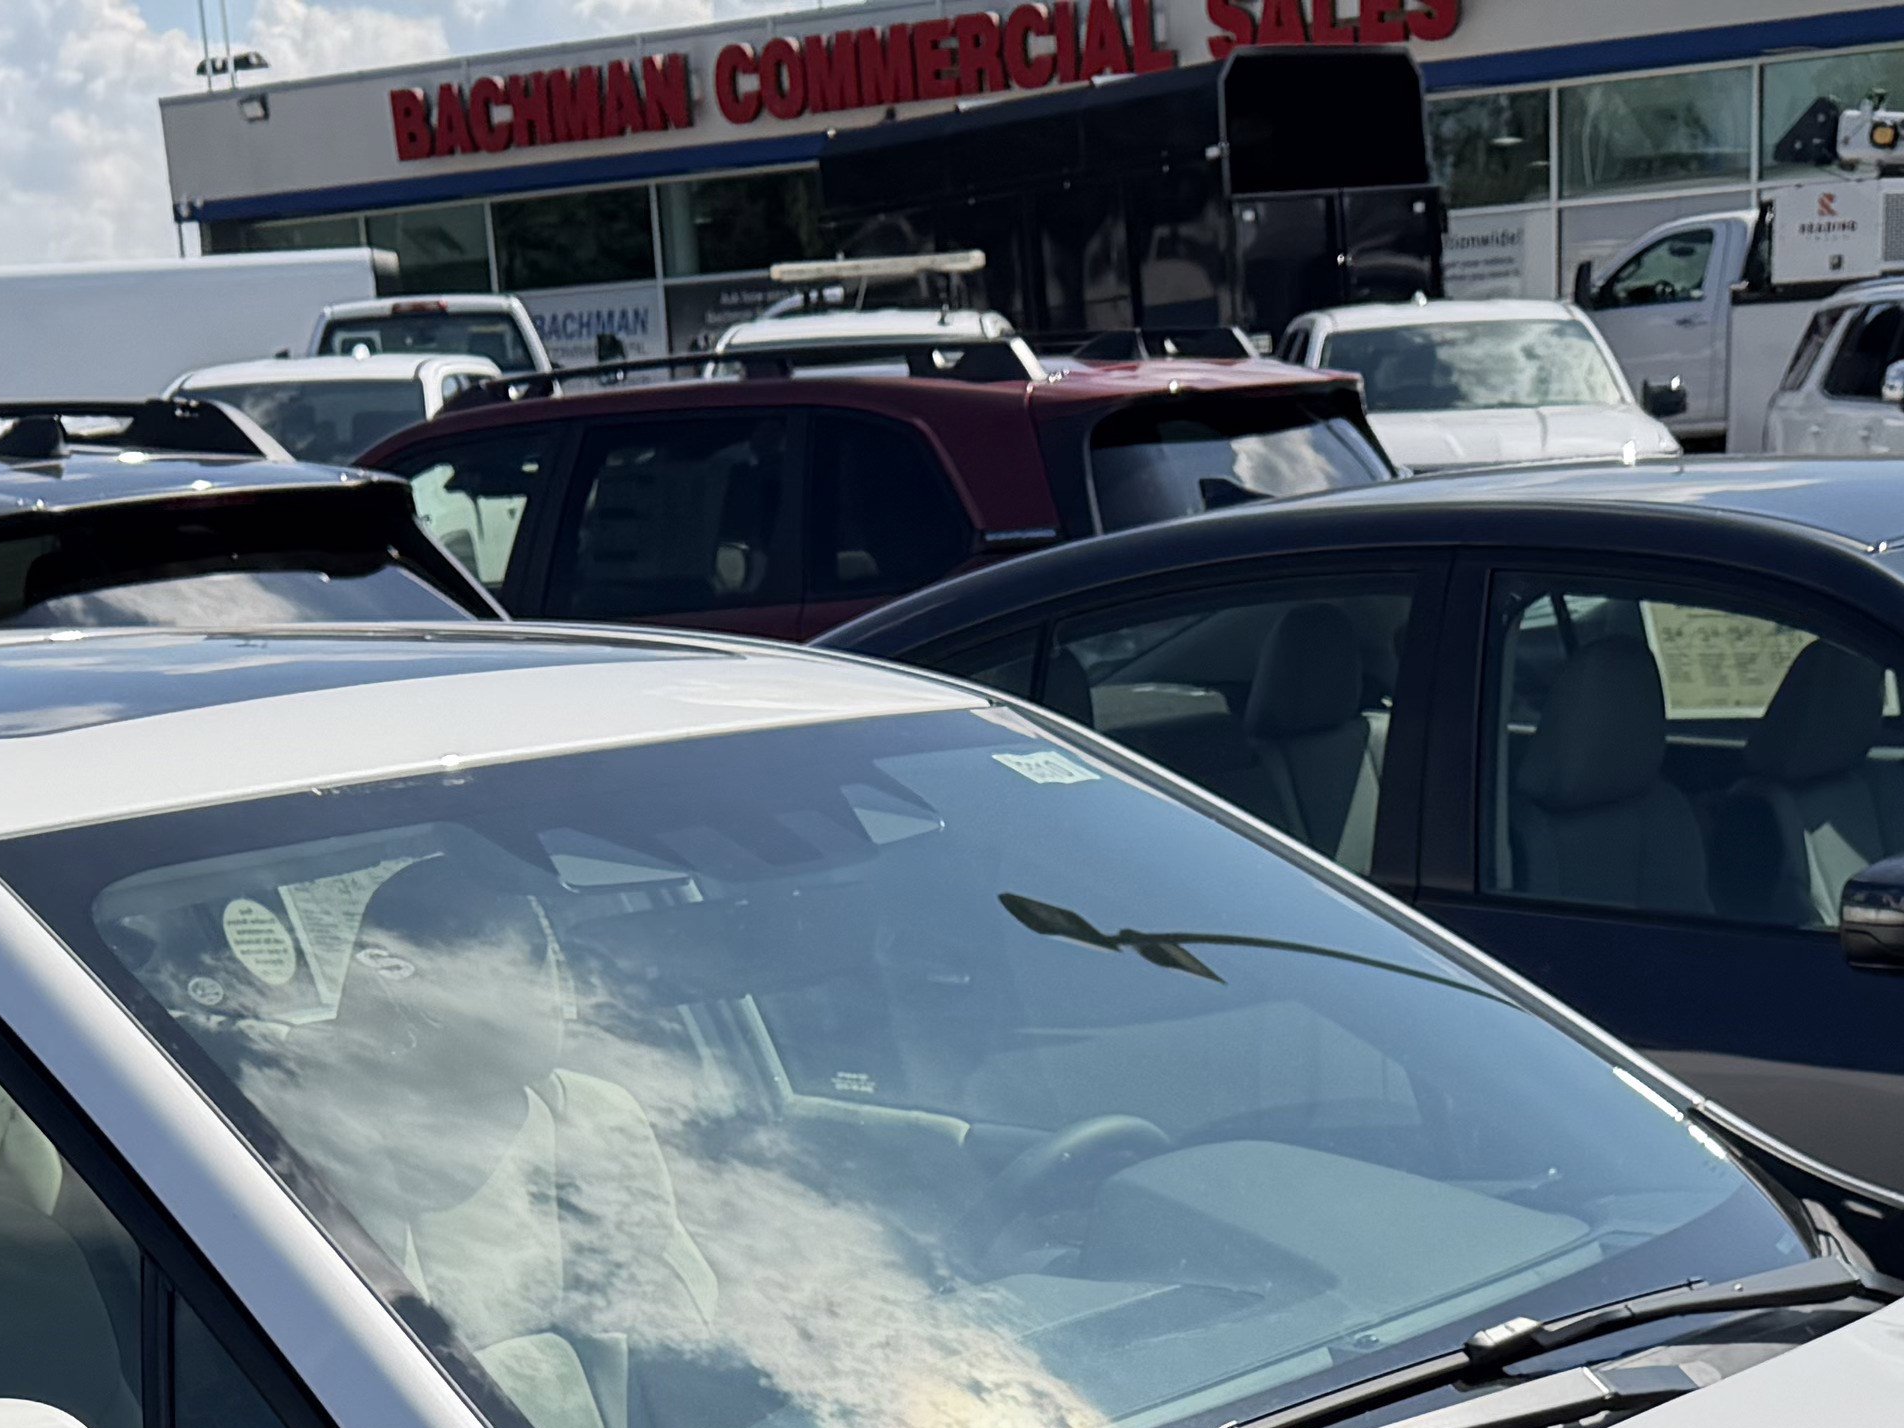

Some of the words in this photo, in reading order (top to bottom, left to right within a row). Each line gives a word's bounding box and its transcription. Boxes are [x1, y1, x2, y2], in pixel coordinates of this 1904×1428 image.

[390, 57, 694, 161] BACHMAN
[716, 0, 1174, 125] COMMERCIAL
[534, 306, 649, 343] BACHMAN
